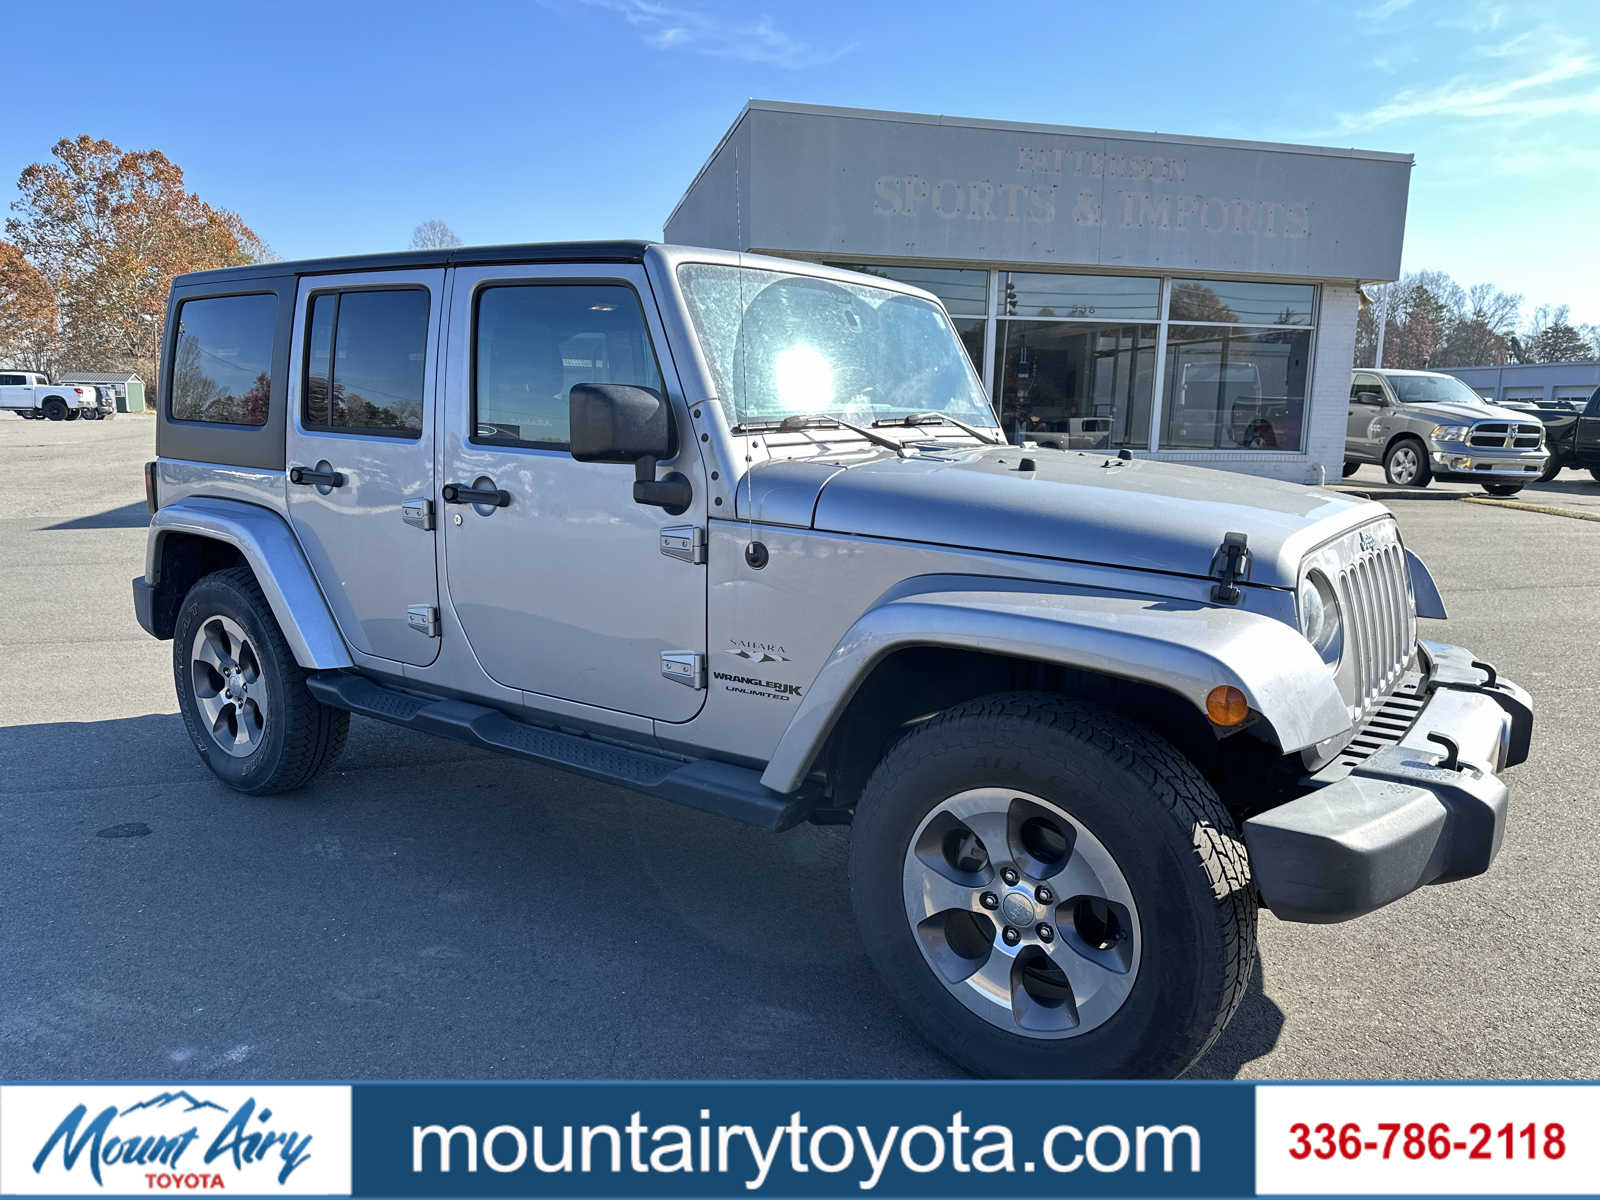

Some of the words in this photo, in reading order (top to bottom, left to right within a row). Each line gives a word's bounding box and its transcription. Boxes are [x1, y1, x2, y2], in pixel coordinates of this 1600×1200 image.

[873, 175, 1056, 224] SPORTS
[1072, 190, 1103, 227] &
[1119, 191, 1311, 240] IMPORTS
[729, 639, 786, 654] SAHARA
[725, 685, 791, 702] UNLIMITED
